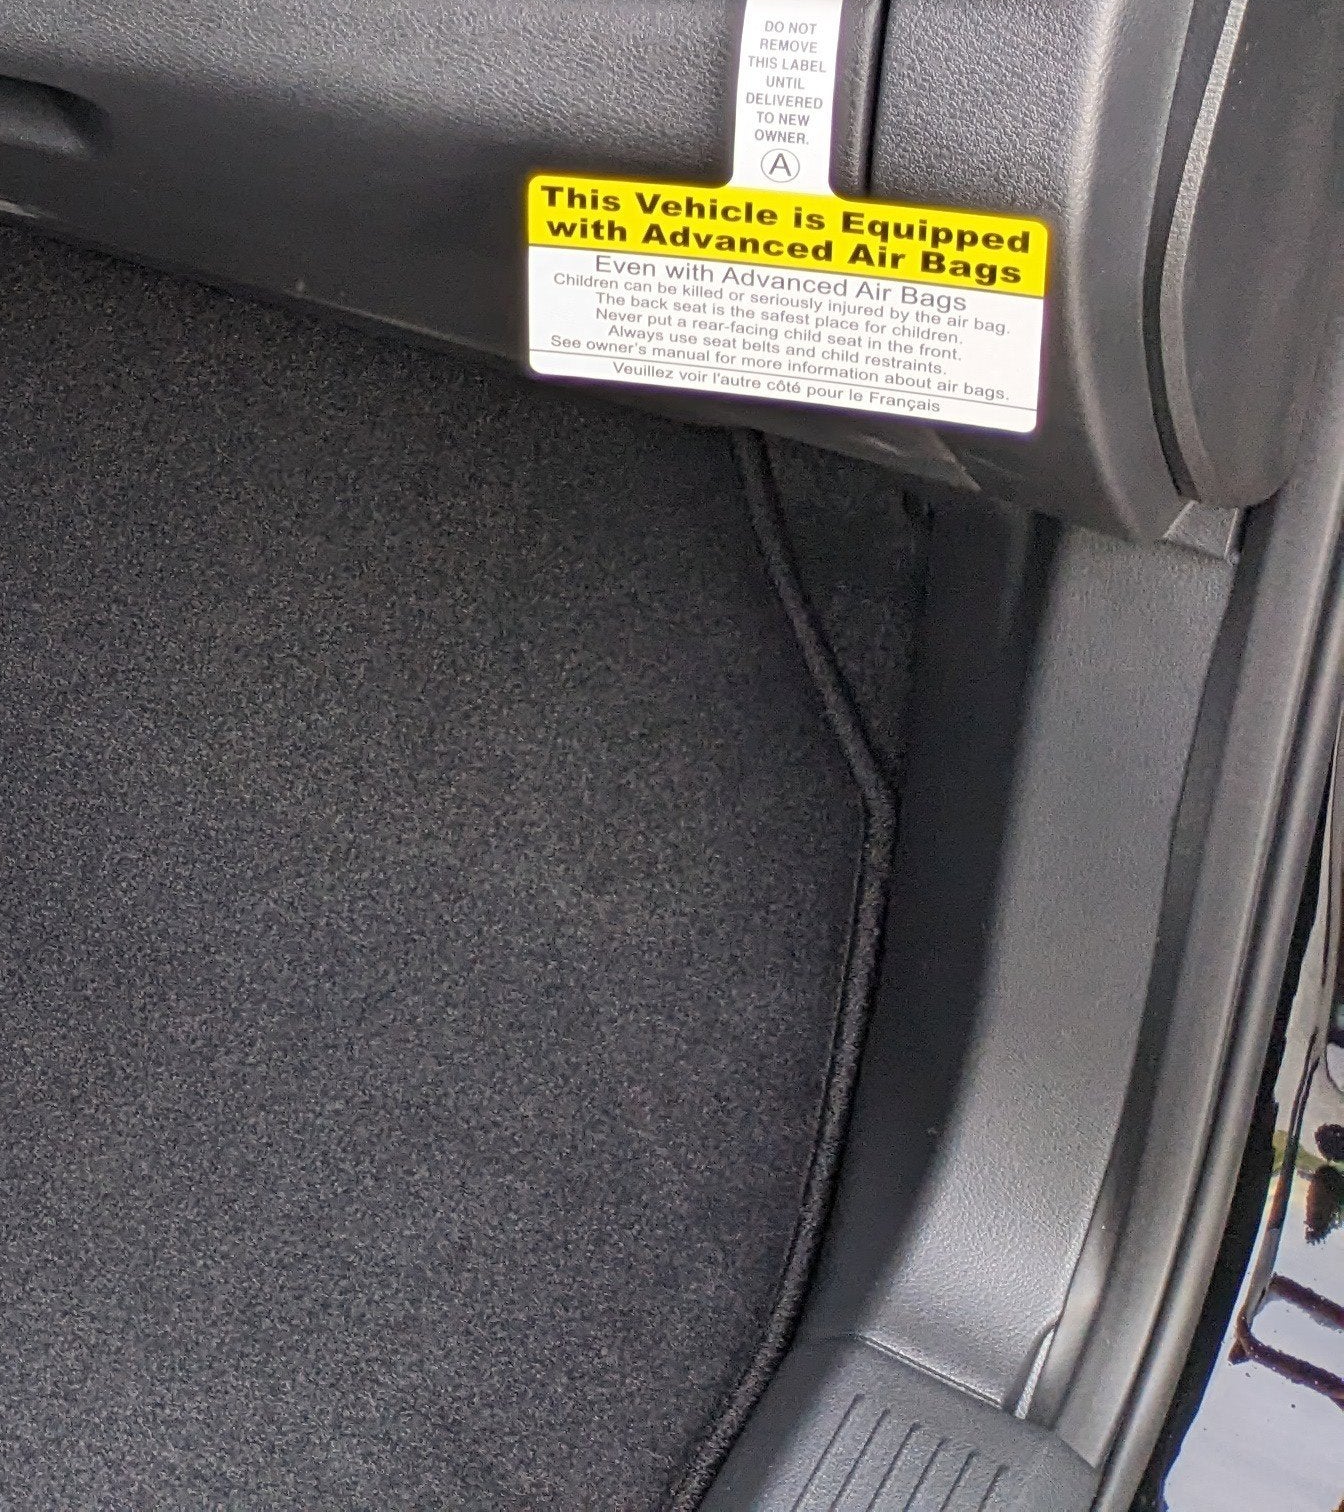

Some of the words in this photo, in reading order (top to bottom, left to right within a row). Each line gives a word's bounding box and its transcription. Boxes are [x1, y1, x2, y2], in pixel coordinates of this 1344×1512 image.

[760, 38, 817, 53] REMOVE
[765, 20, 784, 33] DO
[789, 22, 817, 35] NOT
[748, 56, 778, 69] THIS
[782, 58, 826, 73] LABEL
[766, 75, 805, 90] UNTIL
[746, 92, 824, 109] DELIVERED
[757, 111, 775, 124] TO
[779, 113, 810, 126] NEW
[755, 129, 809, 145] OWNER.
[769, 153, 792, 176] A
[541, 185, 621, 212] This
[635, 191, 778, 226] Vehicle
[793, 207, 826, 231] is
[841, 211, 1030, 254] Equipped
[546, 218, 627, 242] with
[641, 223, 833, 262] Advanced
[847, 243, 906, 270] Air
[920, 250, 1022, 287] Bags
[553, 272, 619, 290] Children
[624, 281, 652, 293] can
[658, 281, 677, 295] be
[682, 284, 723, 300] killed
[729, 291, 745, 302] or
[750, 291, 822, 313] seriously
[828, 299, 884, 319] injured
[890, 306, 910, 323] by
[916, 310, 941, 325] the
[947, 314, 969, 329] air
[974, 318, 1011, 337] bag.
[595, 254, 656, 277] Even
[665, 263, 713, 283] with
[722, 266, 847, 297] Advanced
[855, 281, 892, 302] Air
[901, 286, 968, 314] Bags
[595, 292, 625, 306] The
[631, 295, 668, 310] back
[673, 300, 707, 314] seat
[712, 303, 725, 316] is
[730, 304, 755, 319] the
[761, 306, 810, 326] safest
[815, 316, 859, 335] place
[865, 320, 887, 335] for
[892, 323, 963, 344] children.
[595, 308, 642, 324] Never
[647, 313, 673, 328] put
[677, 317, 687, 328] a
[692, 317, 779, 340] rear-facing
[784, 328, 822, 343] child
[827, 334, 863, 348] seat
[868, 336, 882, 350] in
[887, 339, 914, 354] the
[919, 343, 962, 361] front.
[551, 335, 581, 349] See
[586, 340, 647, 356] owner's
[653, 346, 709, 362] manual
[715, 351, 736, 365] for
[741, 356, 782, 370] more
[787, 359, 879, 382] information
[884, 370, 932, 389] about
[937, 377, 959, 393] air
[964, 381, 1010, 402] bags.
[608, 325, 663, 343] Always
[669, 332, 698, 345] use
[703, 334, 737, 349] seat
[742, 339, 780, 355] belts
[785, 344, 816, 358] and
[821, 347, 859, 364] child
[865, 353, 947, 375] restraints.
[612, 361, 674, 380] Veuillez
[679, 369, 708, 383] voir
[713, 372, 761, 390] l'autre
[766, 378, 801, 395] côté
[807, 385, 844, 401] pour
[849, 388, 863, 402] le
[869, 391, 941, 413] Français
